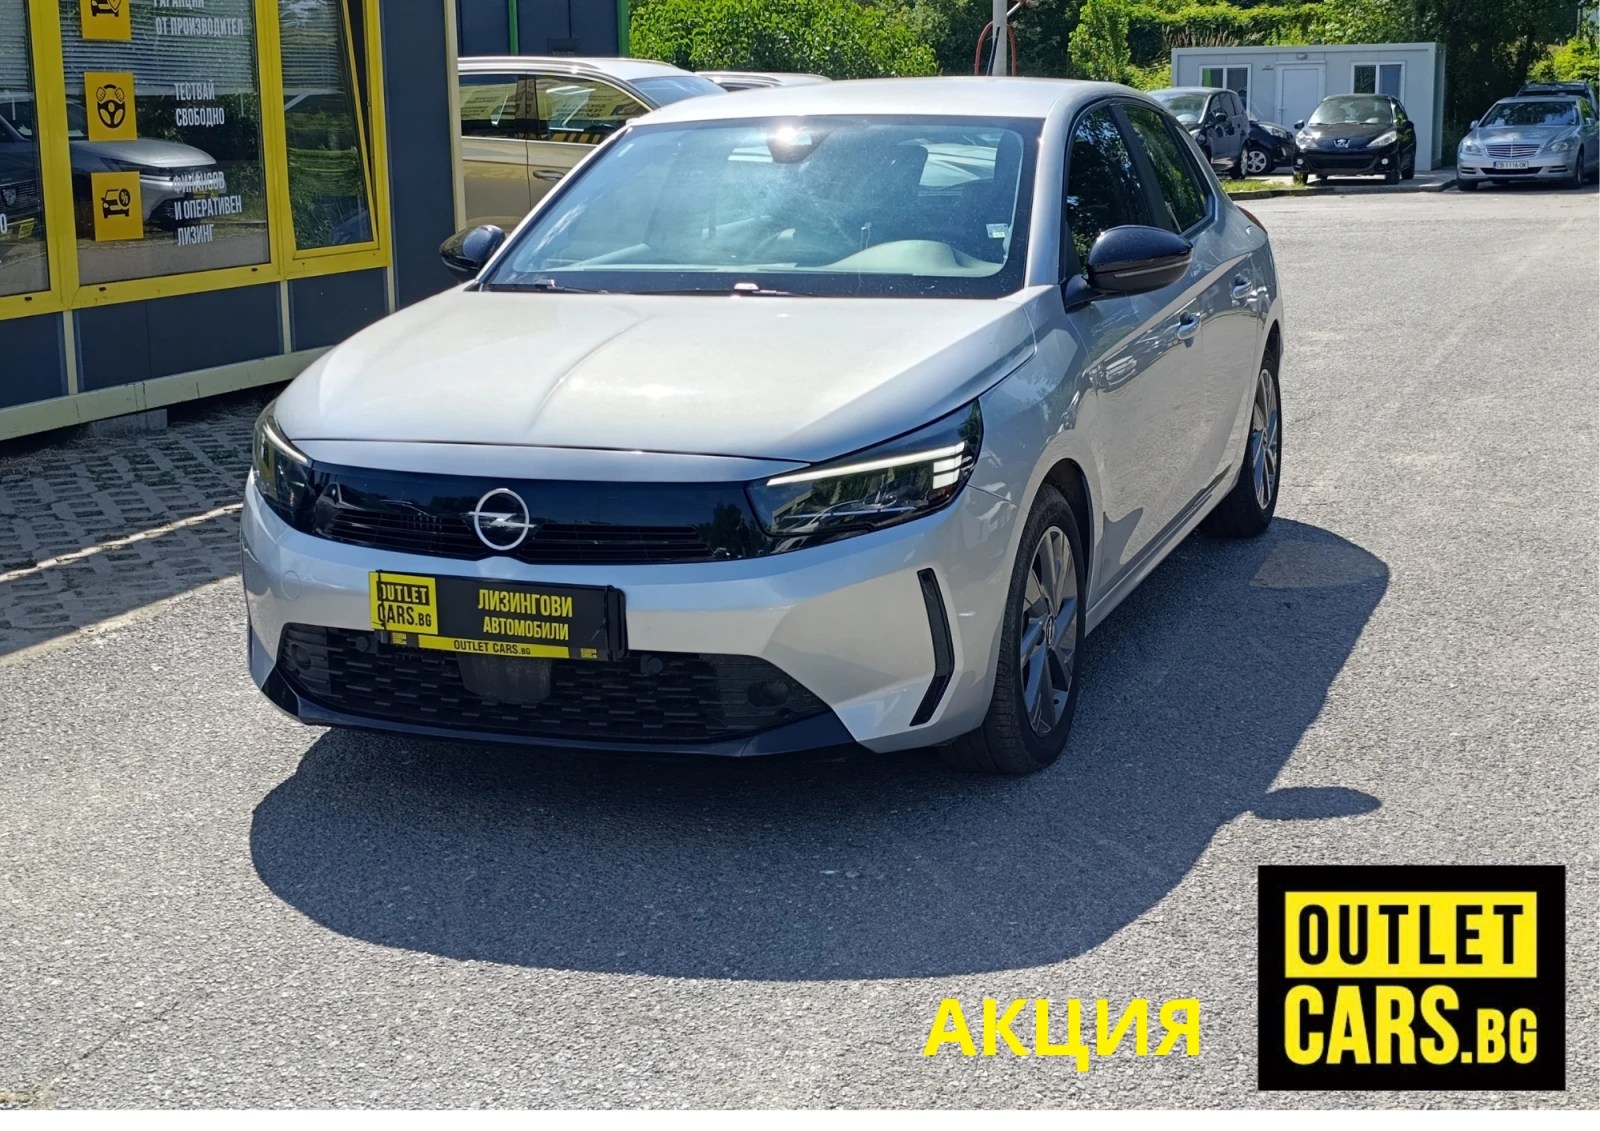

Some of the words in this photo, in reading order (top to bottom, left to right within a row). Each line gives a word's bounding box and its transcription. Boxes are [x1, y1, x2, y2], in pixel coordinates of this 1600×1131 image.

[156, 17, 168, 35] ОТ
[170, 17, 243, 37] ПРОИЗВОДИТЕЛ
[174, 80, 215, 101] ТЕСТВАЙ
[175, 107, 225, 127] СВОБОДНО
[173, 171, 225, 194] ФИНАНСОВ
[174, 201, 183, 221] И
[183, 195, 243, 220] ОПЕРАТИВЕН
[177, 223, 215, 247] ЛИЗИНГ
[377, 603, 432, 627] CARS.BG
[477, 589, 573, 618] ЛИЗИНГОВИ
[483, 616, 569, 641] АВТОМОБИЛИ
[453, 639, 490, 652] OUTLET
[492, 642, 531, 655] CARS.BG
